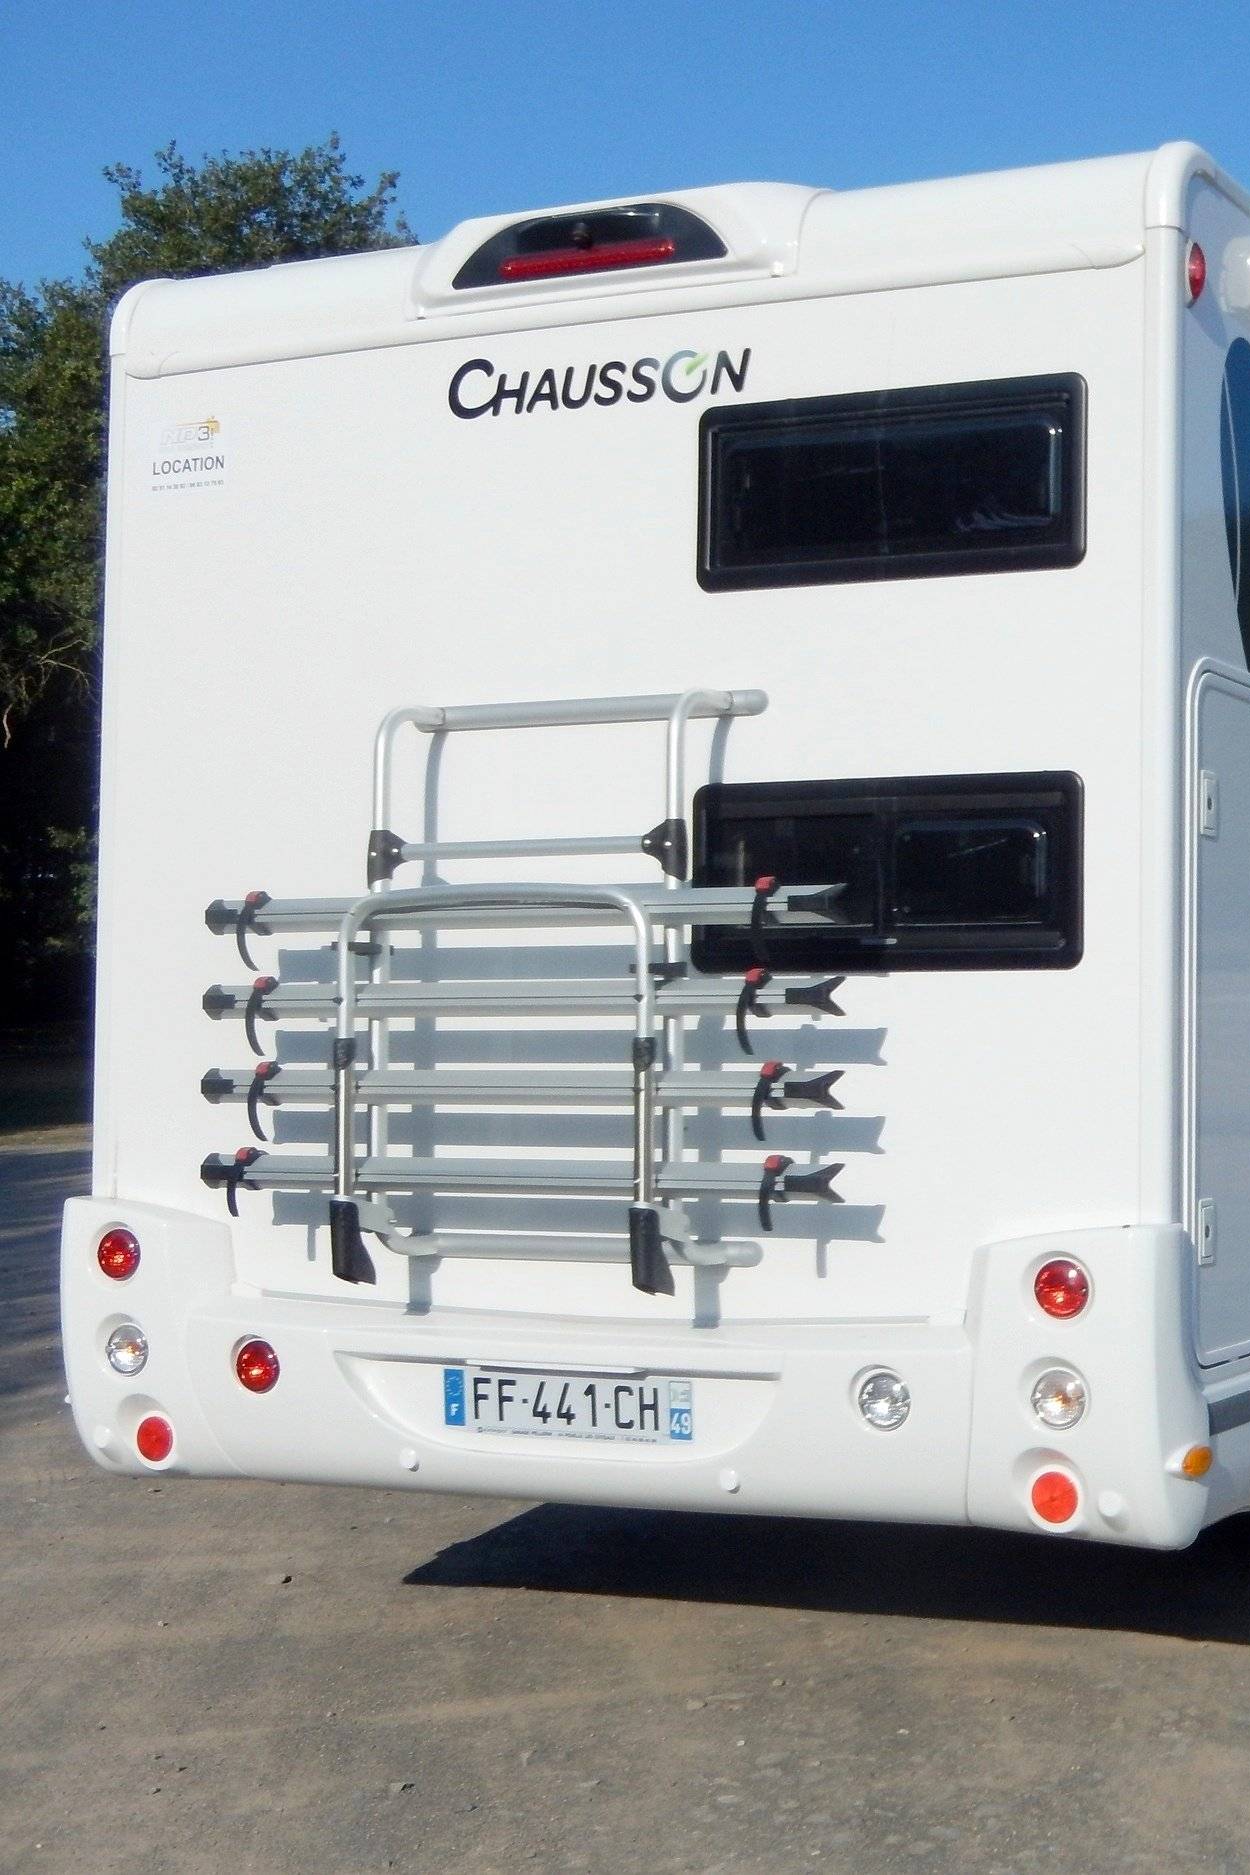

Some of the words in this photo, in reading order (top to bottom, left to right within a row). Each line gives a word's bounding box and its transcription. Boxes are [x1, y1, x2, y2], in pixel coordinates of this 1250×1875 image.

[448, 347, 752, 419] CHAUSSON
[152, 455, 225, 476] LOCATION
[473, 1376, 660, 1432] FF-441-CH
[671, 1412, 691, 1435] 49
